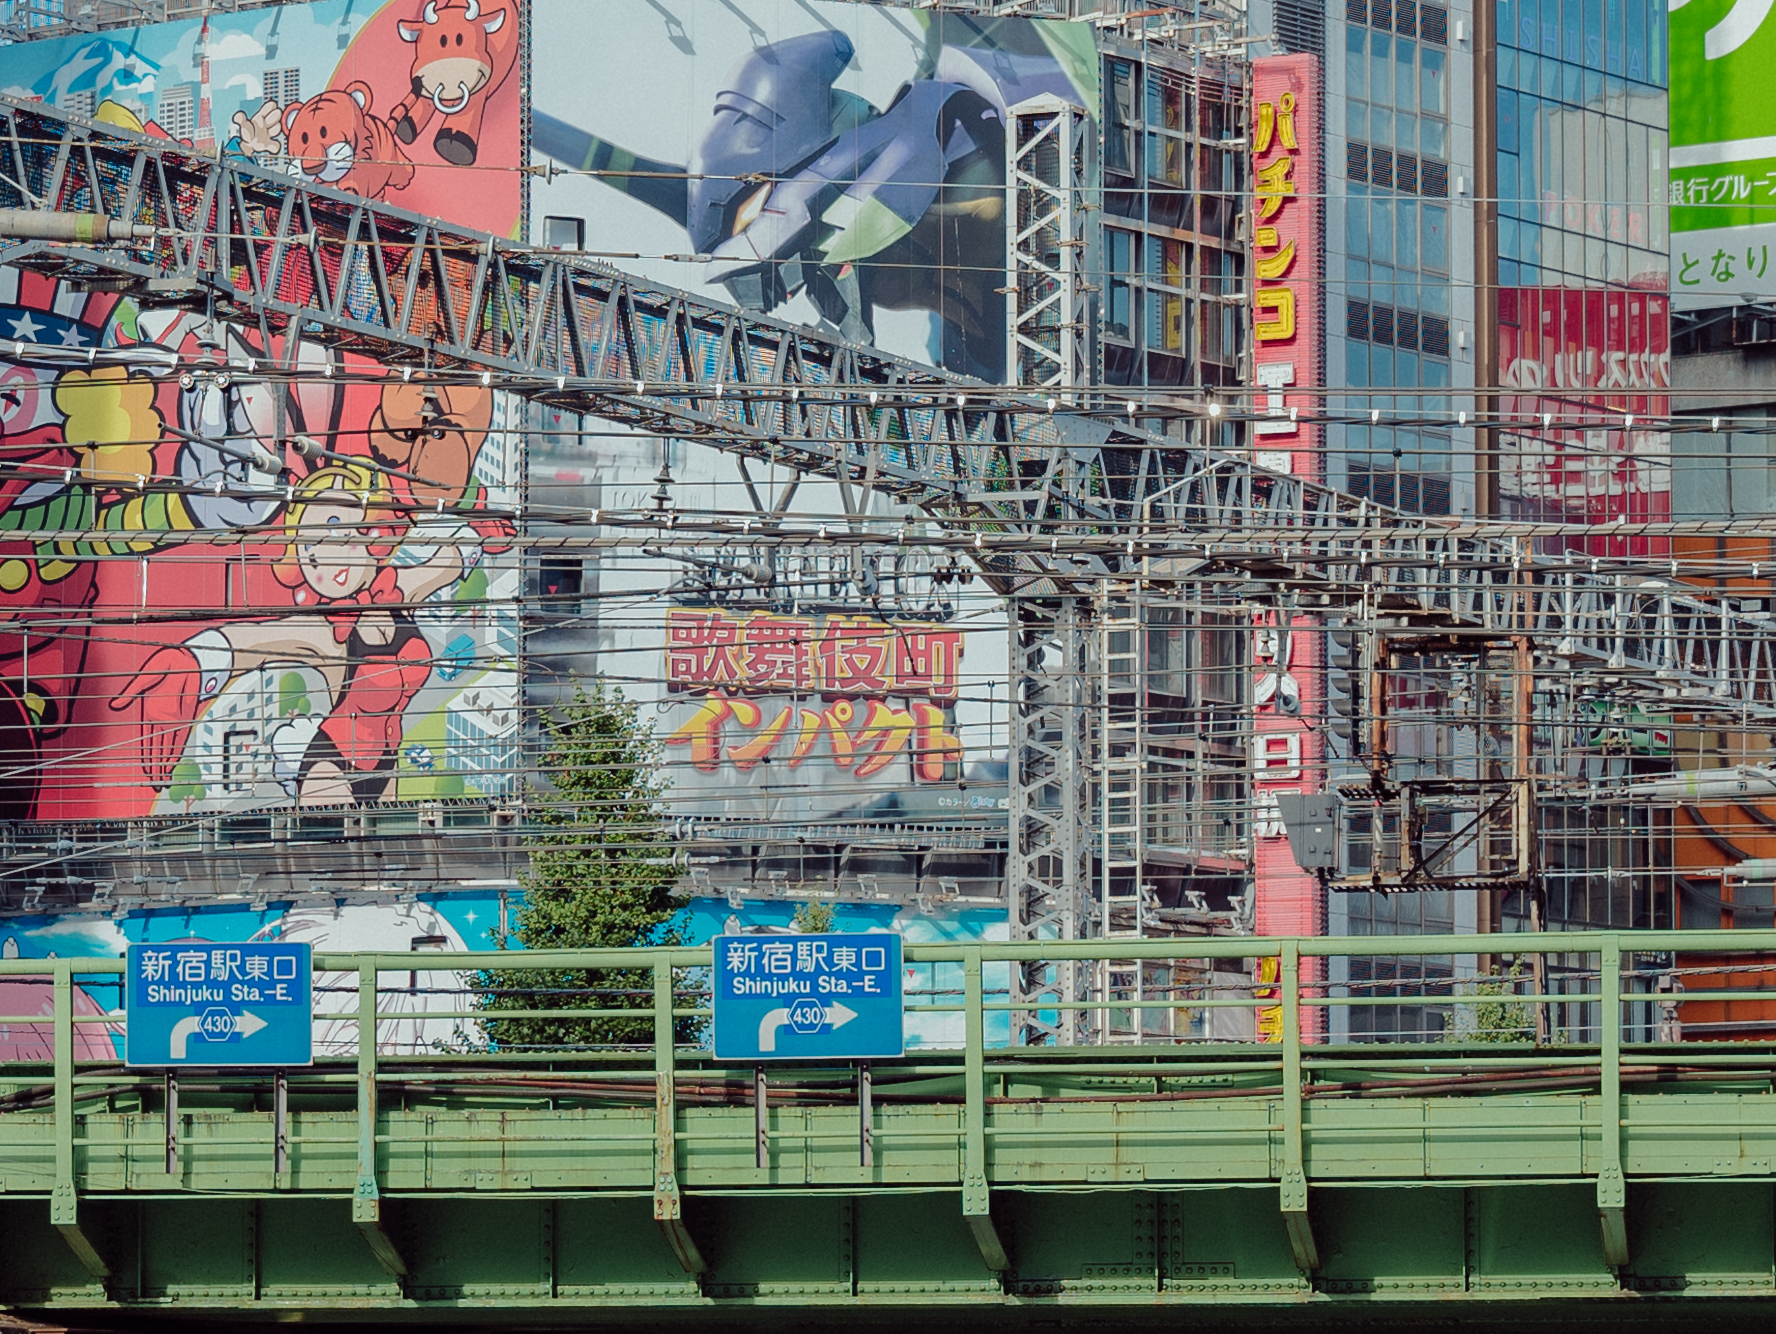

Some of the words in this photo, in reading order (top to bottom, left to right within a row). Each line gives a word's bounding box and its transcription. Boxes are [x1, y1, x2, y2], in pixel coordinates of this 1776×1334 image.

[1521, 17, 1643, 80] SHISHA
[1253, 92, 1298, 342] パチンコ
[1543, 191, 1642, 243] POKER
[1679, 243, 1768, 286] となり
[665, 609, 965, 699] 歌舞伎町
[665, 692, 964, 782] インパクト
[141, 949, 297, 981] 新宿駅東口
[726, 942, 886, 974] 新宿駅東口
[147, 984, 224, 1005] Shinjuku
[732, 976, 811, 997] Shinjuku
[203, 1015, 231, 1034] 430
[792, 1007, 821, 1025] 430
